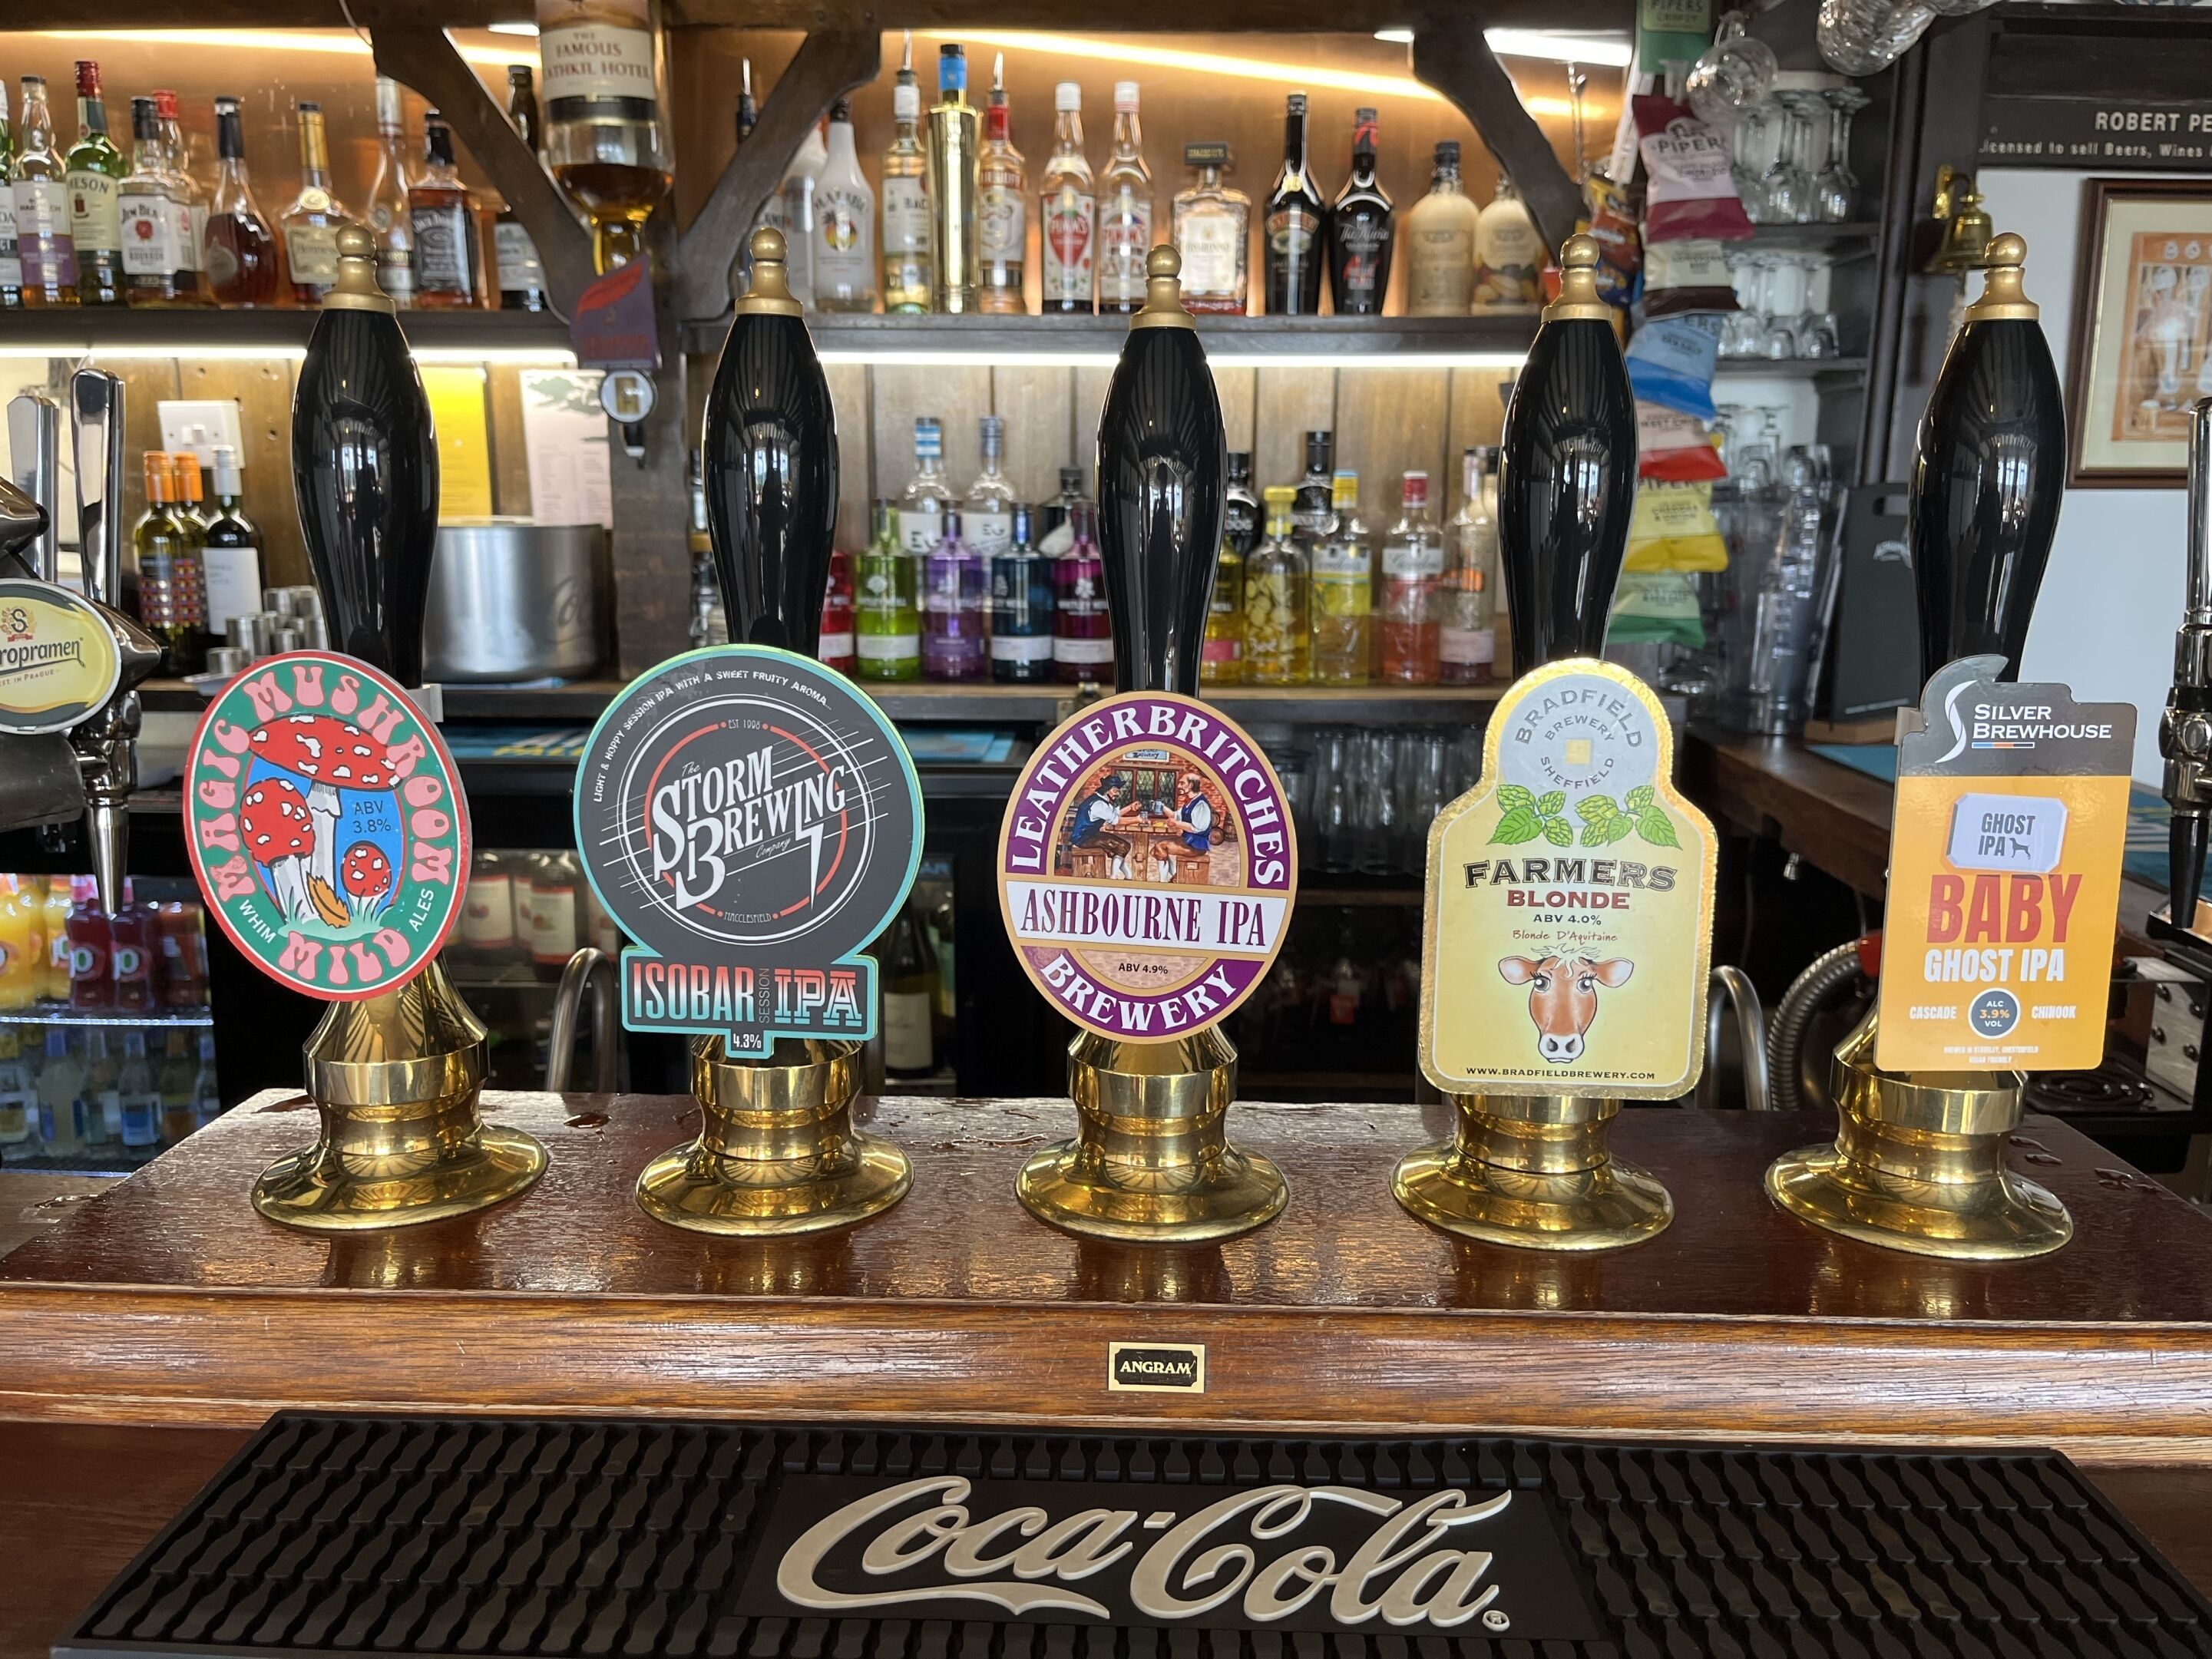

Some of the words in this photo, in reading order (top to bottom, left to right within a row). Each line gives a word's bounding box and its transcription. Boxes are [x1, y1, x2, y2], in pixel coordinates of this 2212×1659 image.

[556, 41, 623, 58] FAMOUS
[601, 61, 653, 80] HOTEL
[2095, 111, 2181, 131] ROBERT
[2188, 114, 2212, 132] PE
[2048, 140, 2064, 154] to
[2070, 141, 2098, 155] sell
[2105, 142, 2151, 158] Beers,
[2158, 144, 2203, 157] Wines
[14, 676, 22, 684] IN
[24, 669, 54, 681] PRAGUE
[676, 675, 701, 691] WITH
[703, 673, 713, 682] A
[716, 669, 749, 680] SWEET
[752, 670, 789, 686] FRUITY
[654, 686, 675, 703] IPA
[623, 699, 656, 731] SESSION
[1515, 689, 1642, 749] BRADFIELD
[1973, 703, 2052, 721] SILVER
[728, 719, 739, 729] EST
[1544, 715, 1615, 742] BREWERY
[1972, 722, 2112, 739] BREWHOUSE
[604, 731, 626, 762] HOPPY
[601, 762, 610, 772] &
[681, 761, 701, 777] The
[1540, 755, 1615, 790] SHEFFIELD
[198, 719, 256, 903] MAGIC
[243, 665, 453, 886] MUSHROOM
[594, 773, 607, 803] LIGHT
[1011, 705, 1285, 887] LEATHERBRITCHES
[354, 800, 384, 815] ABV
[652, 745, 773, 881] STORM
[352, 817, 392, 834] 3.8%
[1981, 812, 2036, 836] GHOST
[755, 836, 792, 859] Company
[1978, 835, 2005, 857] IPA
[1463, 858, 1679, 892] FARMERS
[1506, 890, 1630, 910] BLONDE
[1926, 874, 2083, 944] BABY
[239, 899, 279, 944] WHIM
[409, 887, 435, 933] ALES
[724, 911, 772, 924] MACCLESFIELD
[1020, 888, 1202, 944] ASHBOURNE
[1216, 901, 1266, 947] IPA
[1533, 914, 1564, 924] ABV
[1567, 914, 1602, 926] 4.0%
[1512, 930, 1551, 940] Blonde
[1557, 930, 1618, 946] D'Aquitaine
[277, 927, 412, 986] MILD
[1923, 948, 2014, 983] GHOST
[2019, 948, 2065, 982] IPA
[1118, 962, 1140, 973] ABV
[1142, 963, 1169, 975] 4.9%
[633, 962, 756, 1023] ISOBAR
[759, 967, 770, 1024] SESSION
[774, 968, 862, 1027] IPA
[1040, 953, 1237, 1032] BREWERY
[1909, 1006, 1957, 1020] CASCADE
[1979, 1009, 2011, 1020] 3.9%
[2031, 1005, 2077, 1020] CHINOOK
[1986, 1000, 2005, 1008] ALC
[1984, 1020, 2003, 1028] VOL
[732, 1033, 762, 1049] 4.3%
[1466, 1067, 1655, 1080] WWW.BRADFIELDBREWERY.COM
[1120, 1361, 1191, 1375] ANGRAM
[777, 1475, 1513, 1628] Coca-Cola
